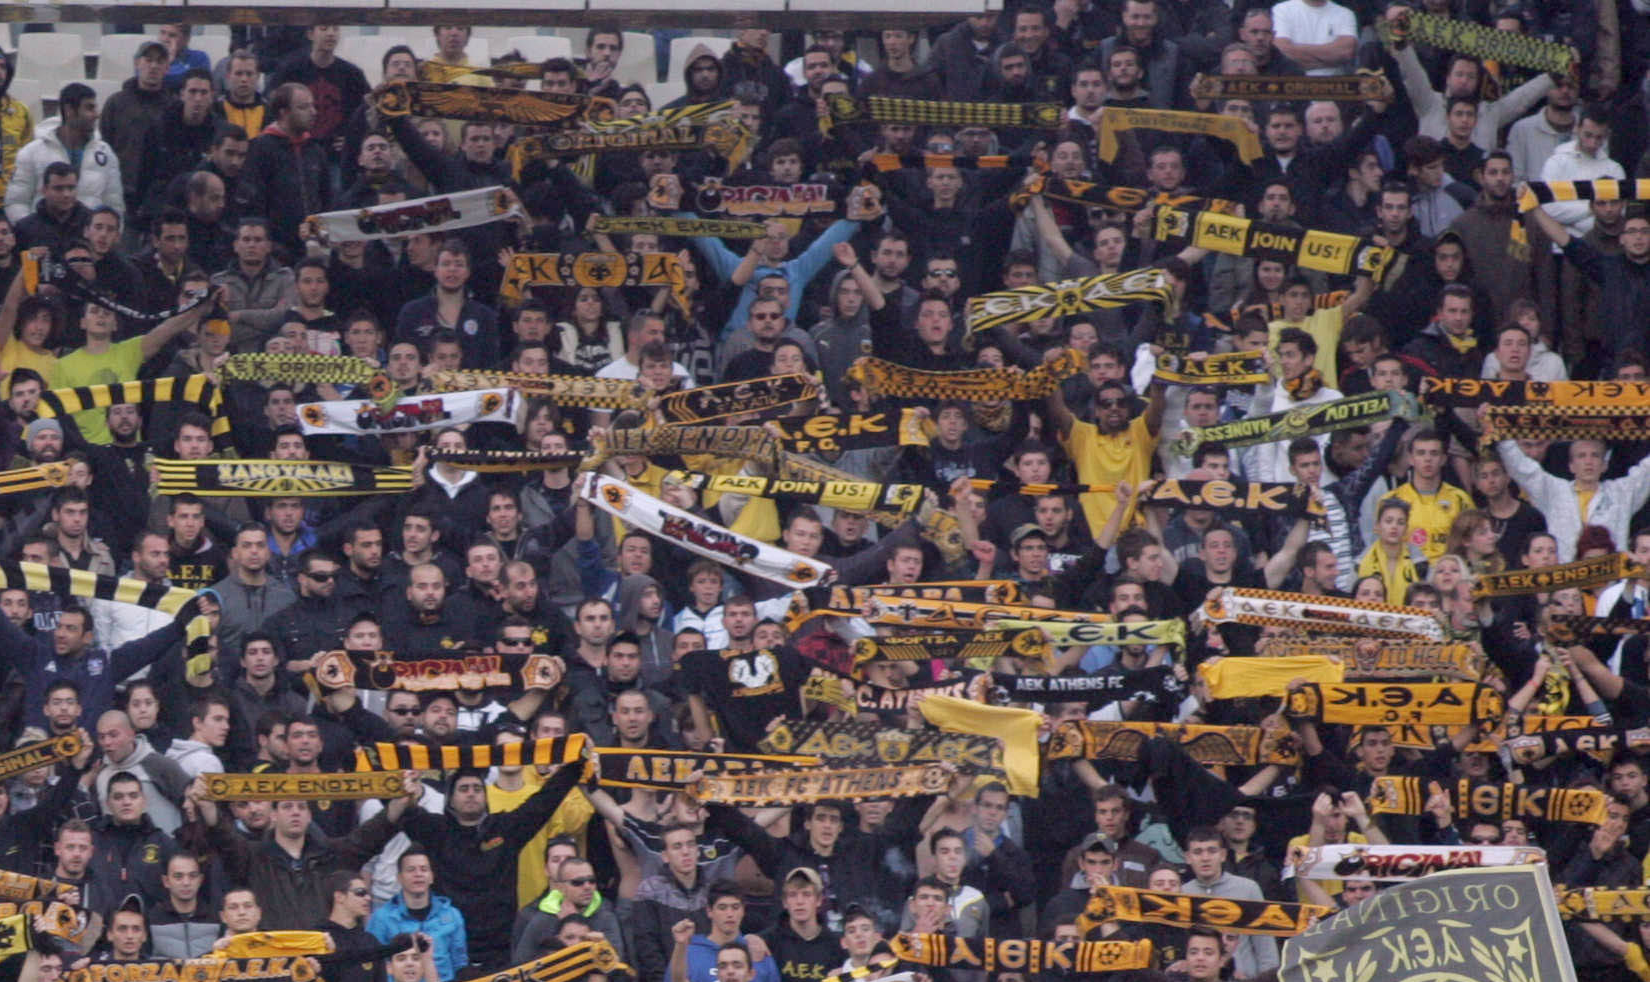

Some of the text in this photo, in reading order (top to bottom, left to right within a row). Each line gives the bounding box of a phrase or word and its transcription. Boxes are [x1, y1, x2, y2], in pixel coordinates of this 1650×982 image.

[1205, 223, 1342, 260] AEK JOIN US!
[721, 476, 868, 498] AEK JOIN US!
[1016, 675, 1125, 692] AEK ATHENS FC
